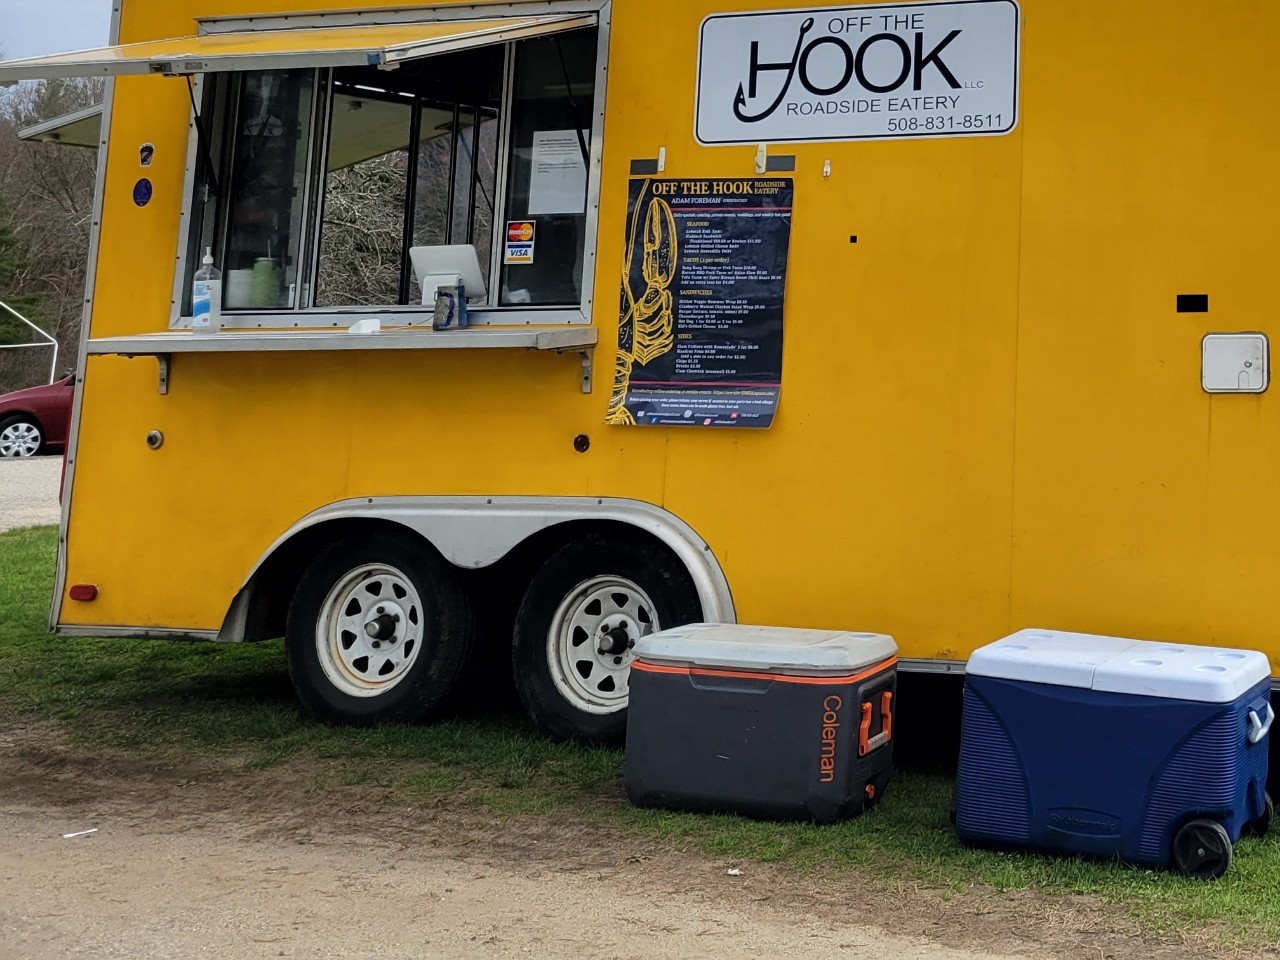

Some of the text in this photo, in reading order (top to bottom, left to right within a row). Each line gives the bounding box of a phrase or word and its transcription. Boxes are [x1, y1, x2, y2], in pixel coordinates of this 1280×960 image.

[828, 14, 924, 34] OFF THE
[733, 17, 984, 122] HOOK LLC
[786, 95, 961, 116] ROADSIDE EATERY
[888, 114, 1002, 132] 508-831-8511
[652, 182, 753, 195] OFF THE HOOK
[820, 694, 842, 784] Coleman
